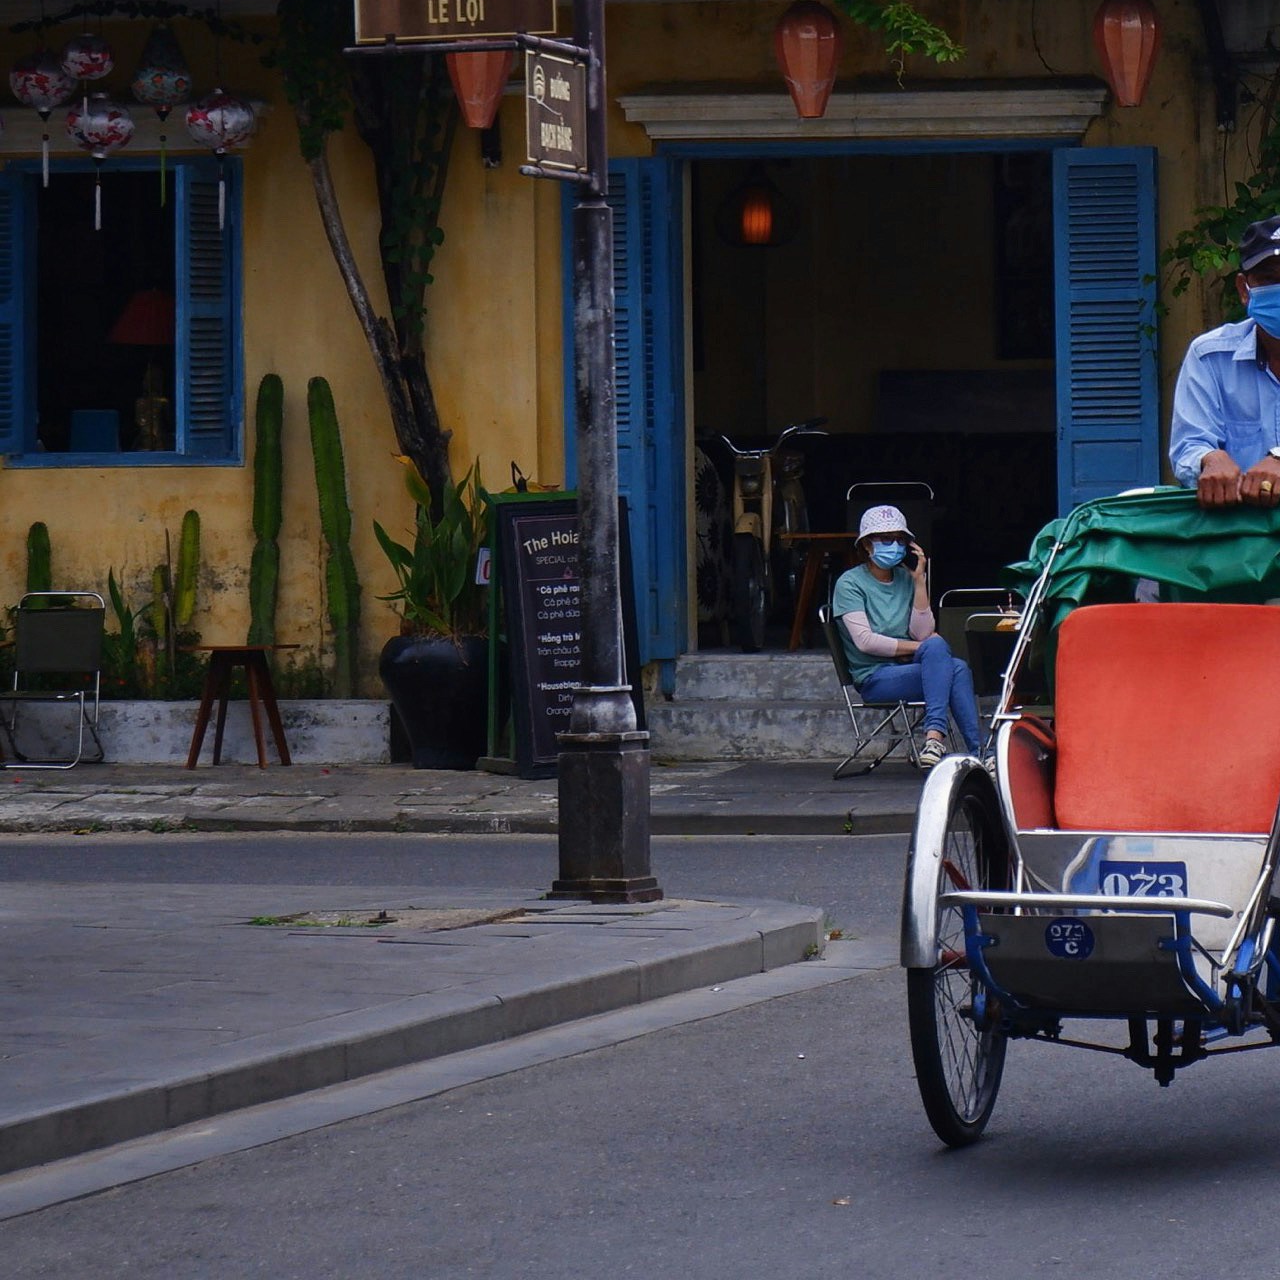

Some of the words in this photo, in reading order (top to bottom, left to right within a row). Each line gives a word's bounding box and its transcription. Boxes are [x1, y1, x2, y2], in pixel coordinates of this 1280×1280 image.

[523, 537, 548, 555] The
[535, 556, 566, 565] SPECIAL
[1064, 941, 1079, 954] C
